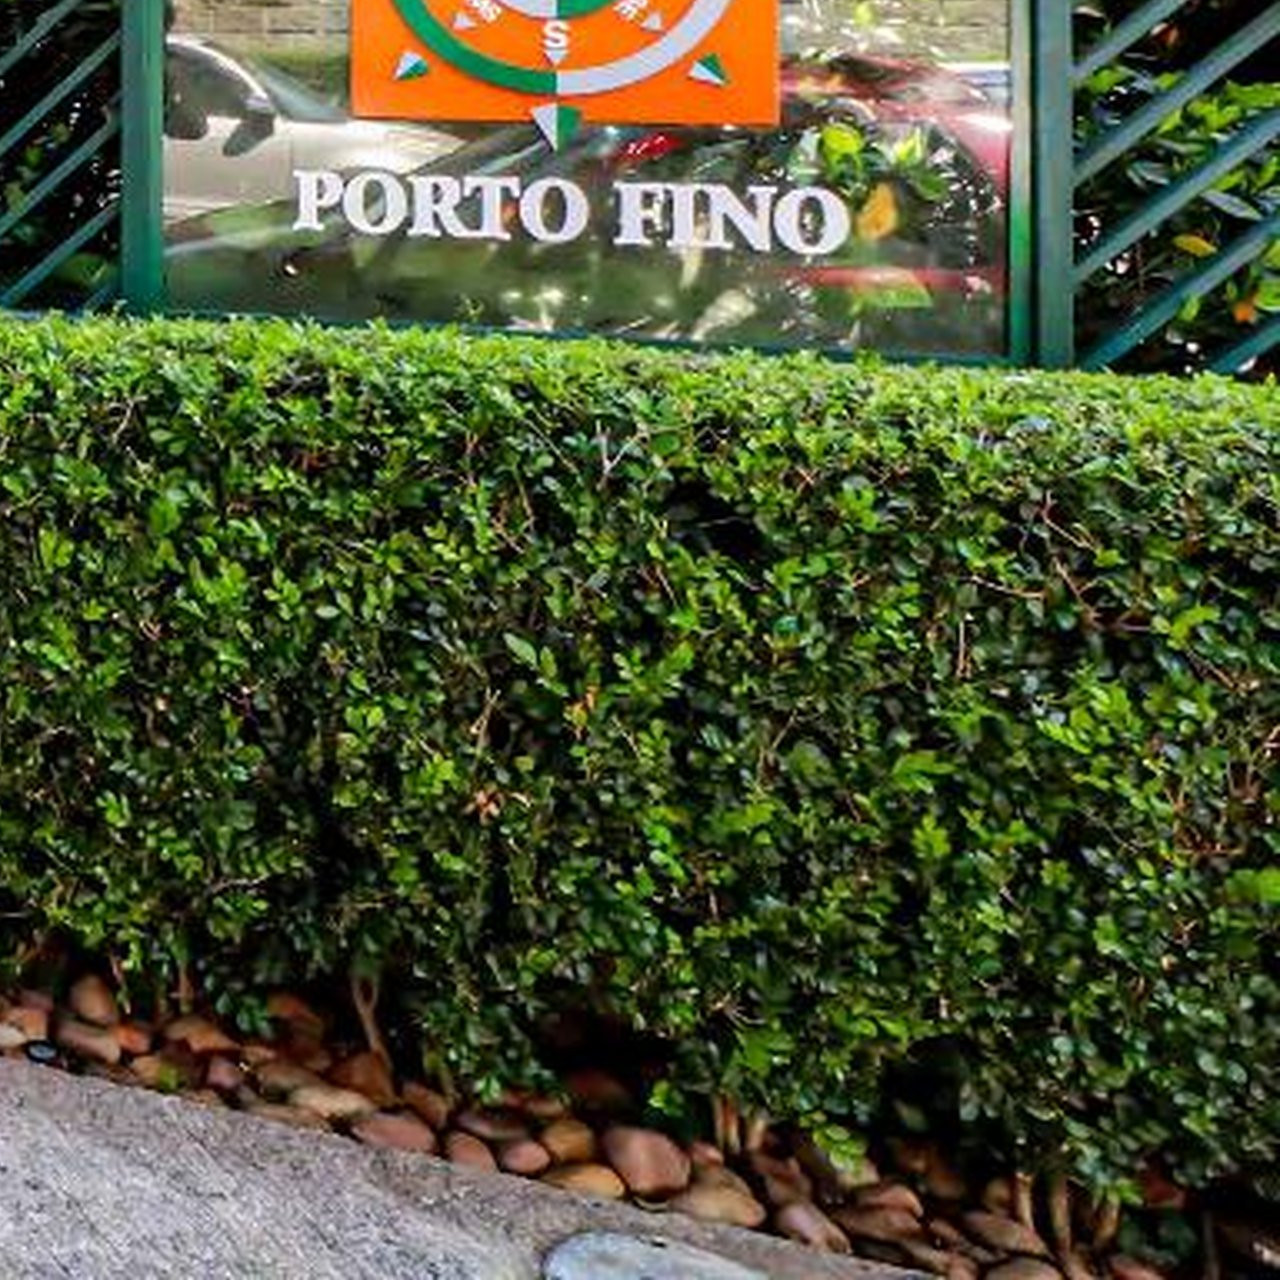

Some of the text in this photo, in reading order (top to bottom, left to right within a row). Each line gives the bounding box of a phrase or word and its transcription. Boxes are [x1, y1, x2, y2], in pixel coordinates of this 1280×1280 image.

[544, 22, 570, 49] S
[292, 169, 852, 256] PORTO FINO
